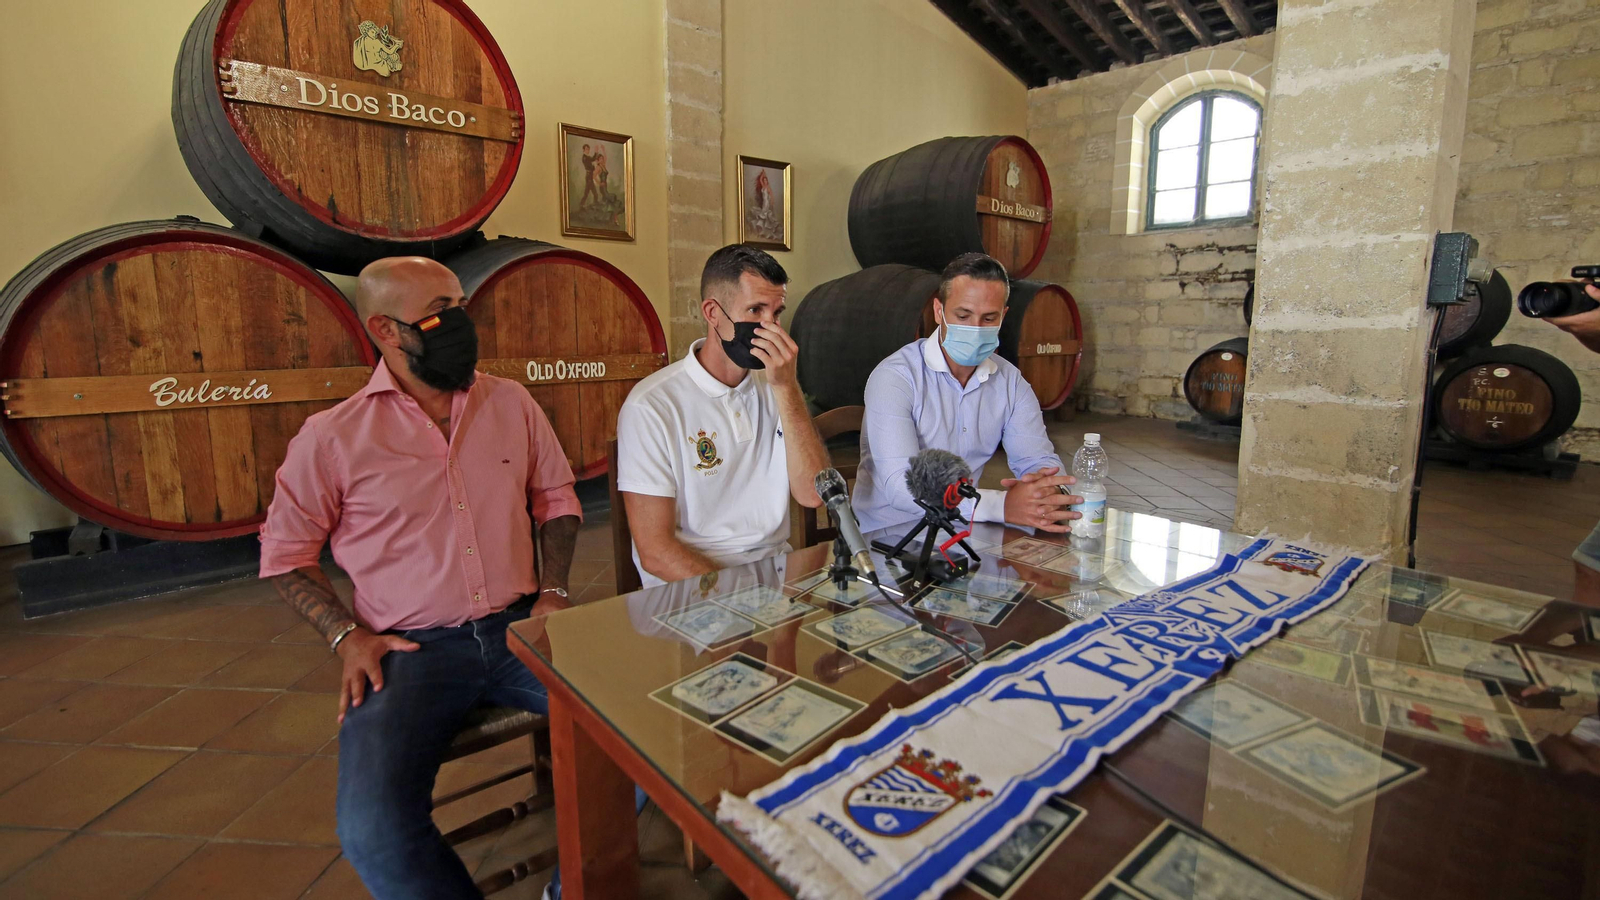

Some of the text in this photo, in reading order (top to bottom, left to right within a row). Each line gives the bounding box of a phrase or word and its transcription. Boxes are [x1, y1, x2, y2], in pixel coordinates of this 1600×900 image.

[296, 77, 466, 128] Dios Baco
[991, 198, 1035, 218] Dios Baco
[526, 359, 606, 381] OLD OXFORD
[149, 376, 273, 407] Bulería
[1477, 387, 1517, 400] FINO
[1485, 400, 1535, 415] MATEO
[704, 469, 719, 477] POLO
[989, 579, 1291, 731] XEREZ
[808, 811, 878, 865] XEREZ
